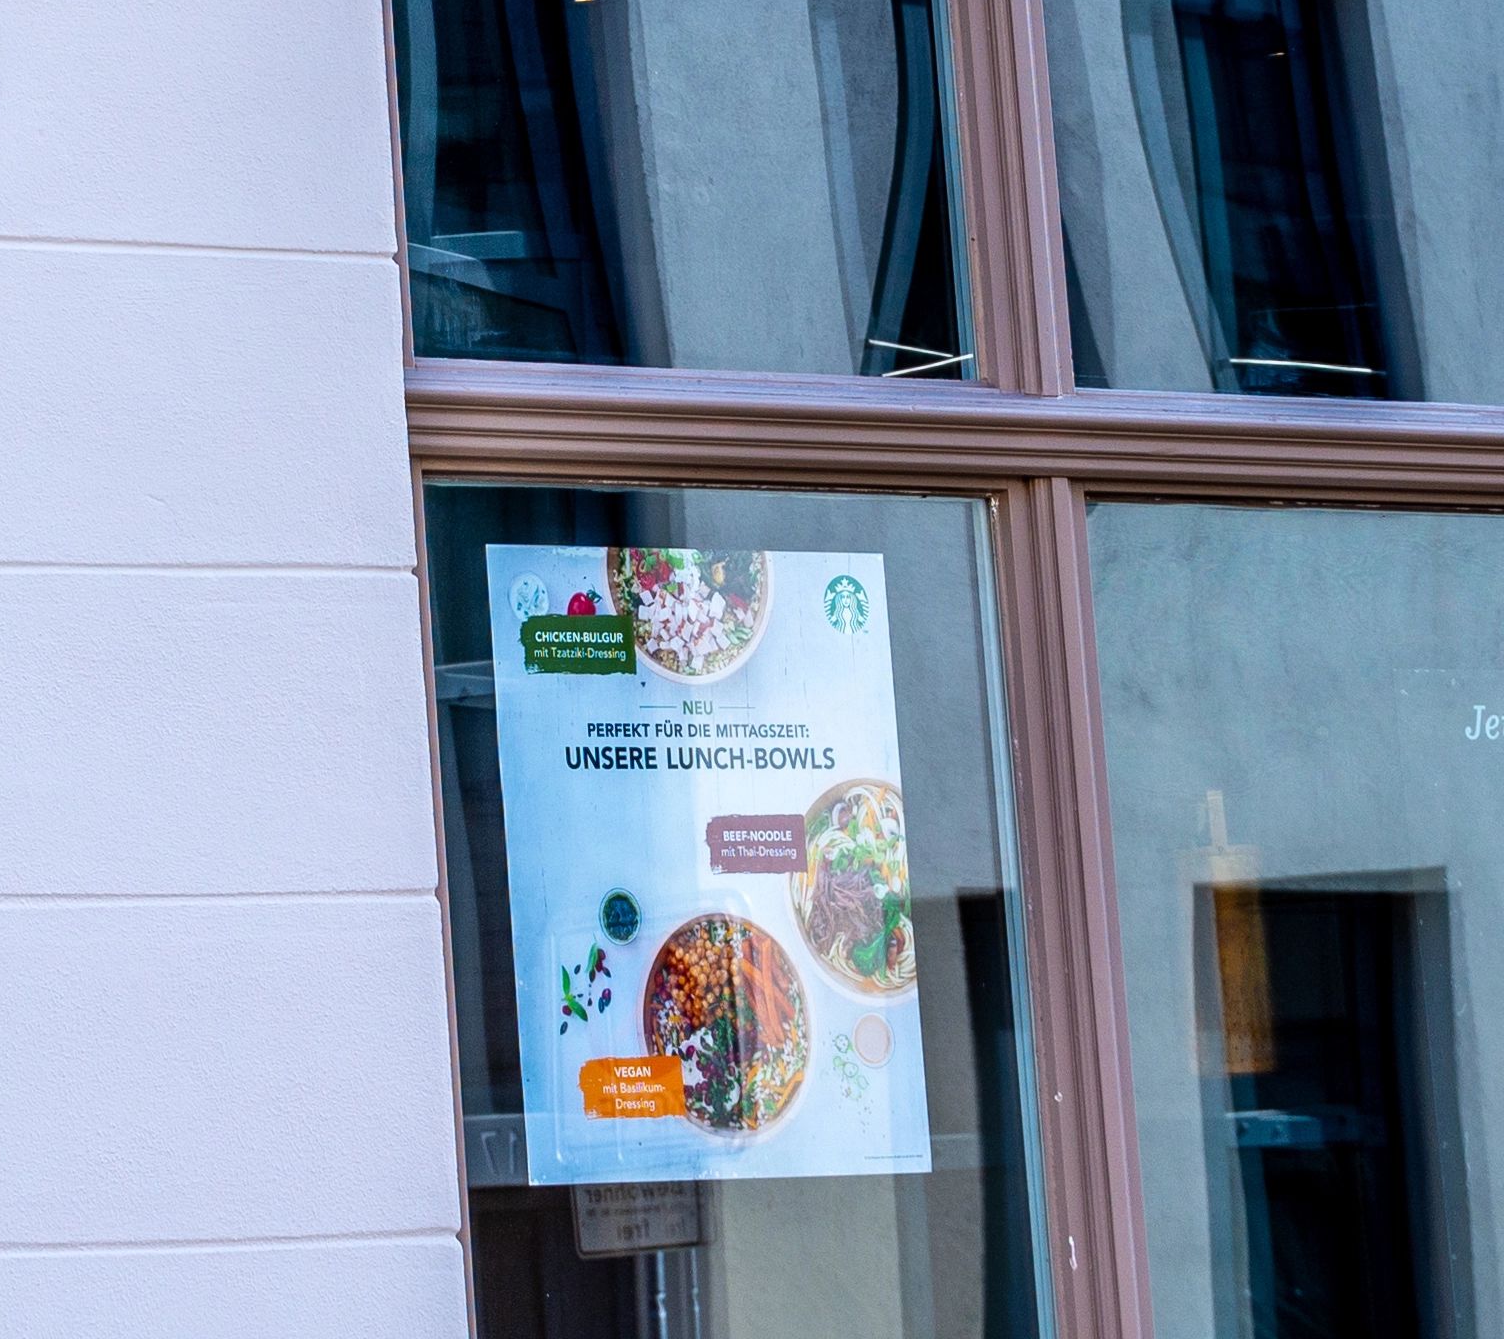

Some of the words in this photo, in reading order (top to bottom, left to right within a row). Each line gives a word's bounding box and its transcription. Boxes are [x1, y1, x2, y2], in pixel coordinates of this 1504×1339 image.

[534, 631, 624, 644] CHICKEN-BULGUR
[533, 647, 549, 659] mit
[551, 646, 627, 662] Tzatziki-Dressing
[682, 700, 714, 715] NEU
[587, 722, 650, 738] PERFEKT
[655, 719, 683, 738] FÜR
[688, 723, 711, 738] DIE
[716, 723, 811, 739] MITTAGSZEIT:
[565, 746, 658, 770] UNSERE
[667, 747, 837, 771] LUNCH-BOWLS
[723, 830, 793, 842] BEEF-NOODLE
[721, 846, 736, 857] mit
[737, 845, 797, 860] Thai-Dressing
[613, 1066, 652, 1078] VEGAN
[602, 1082, 618, 1094] mit
[619, 1081, 666, 1094] Basilikum-
[615, 1098, 656, 1112] Dressing
